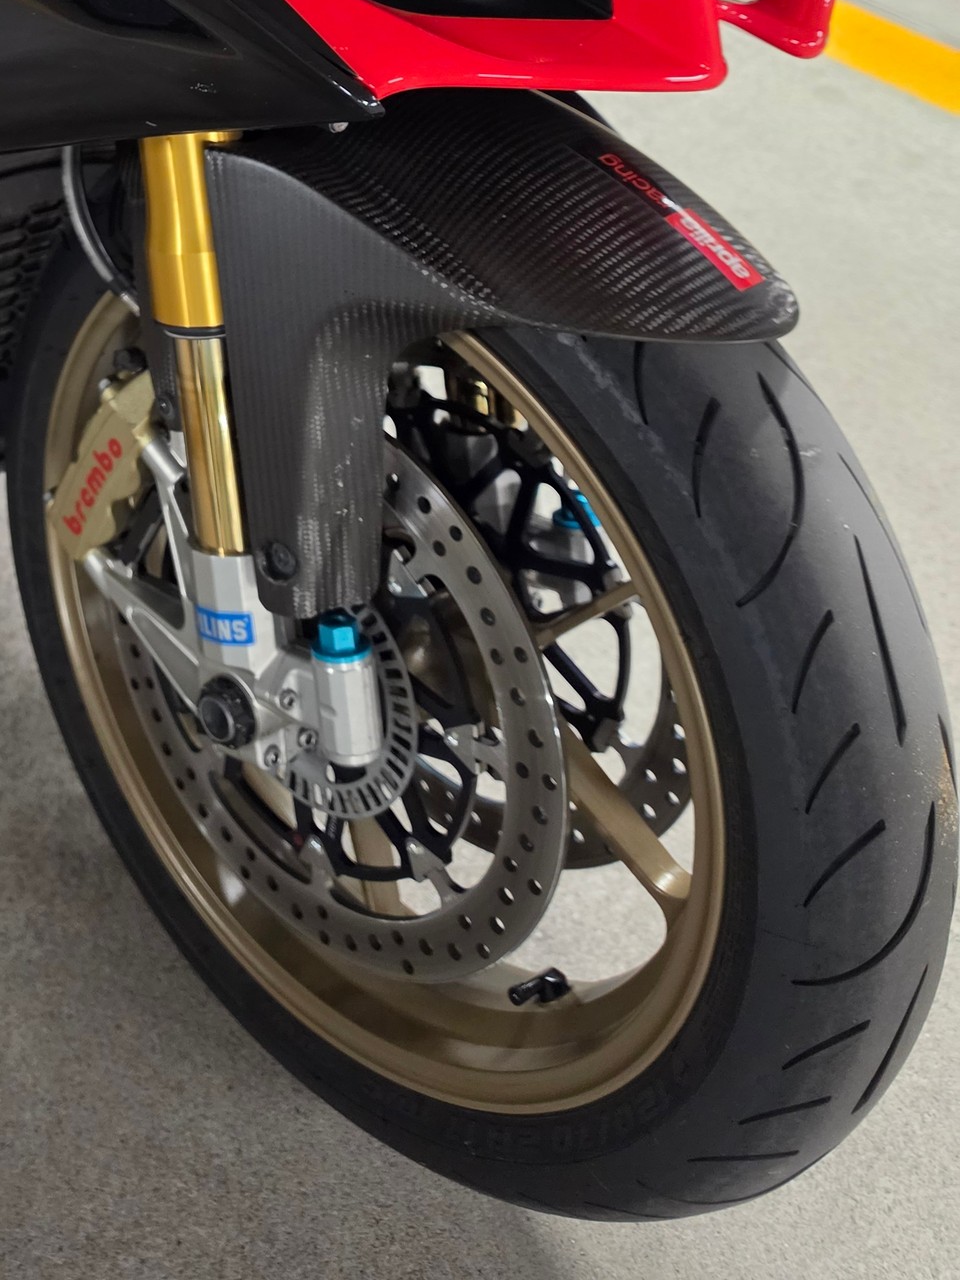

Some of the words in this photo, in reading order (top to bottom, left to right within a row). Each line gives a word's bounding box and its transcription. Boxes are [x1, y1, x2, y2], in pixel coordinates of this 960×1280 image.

[598, 153, 668, 209] racing
[680, 216, 751, 279] aprilia
[62, 437, 123, 536] brembo
